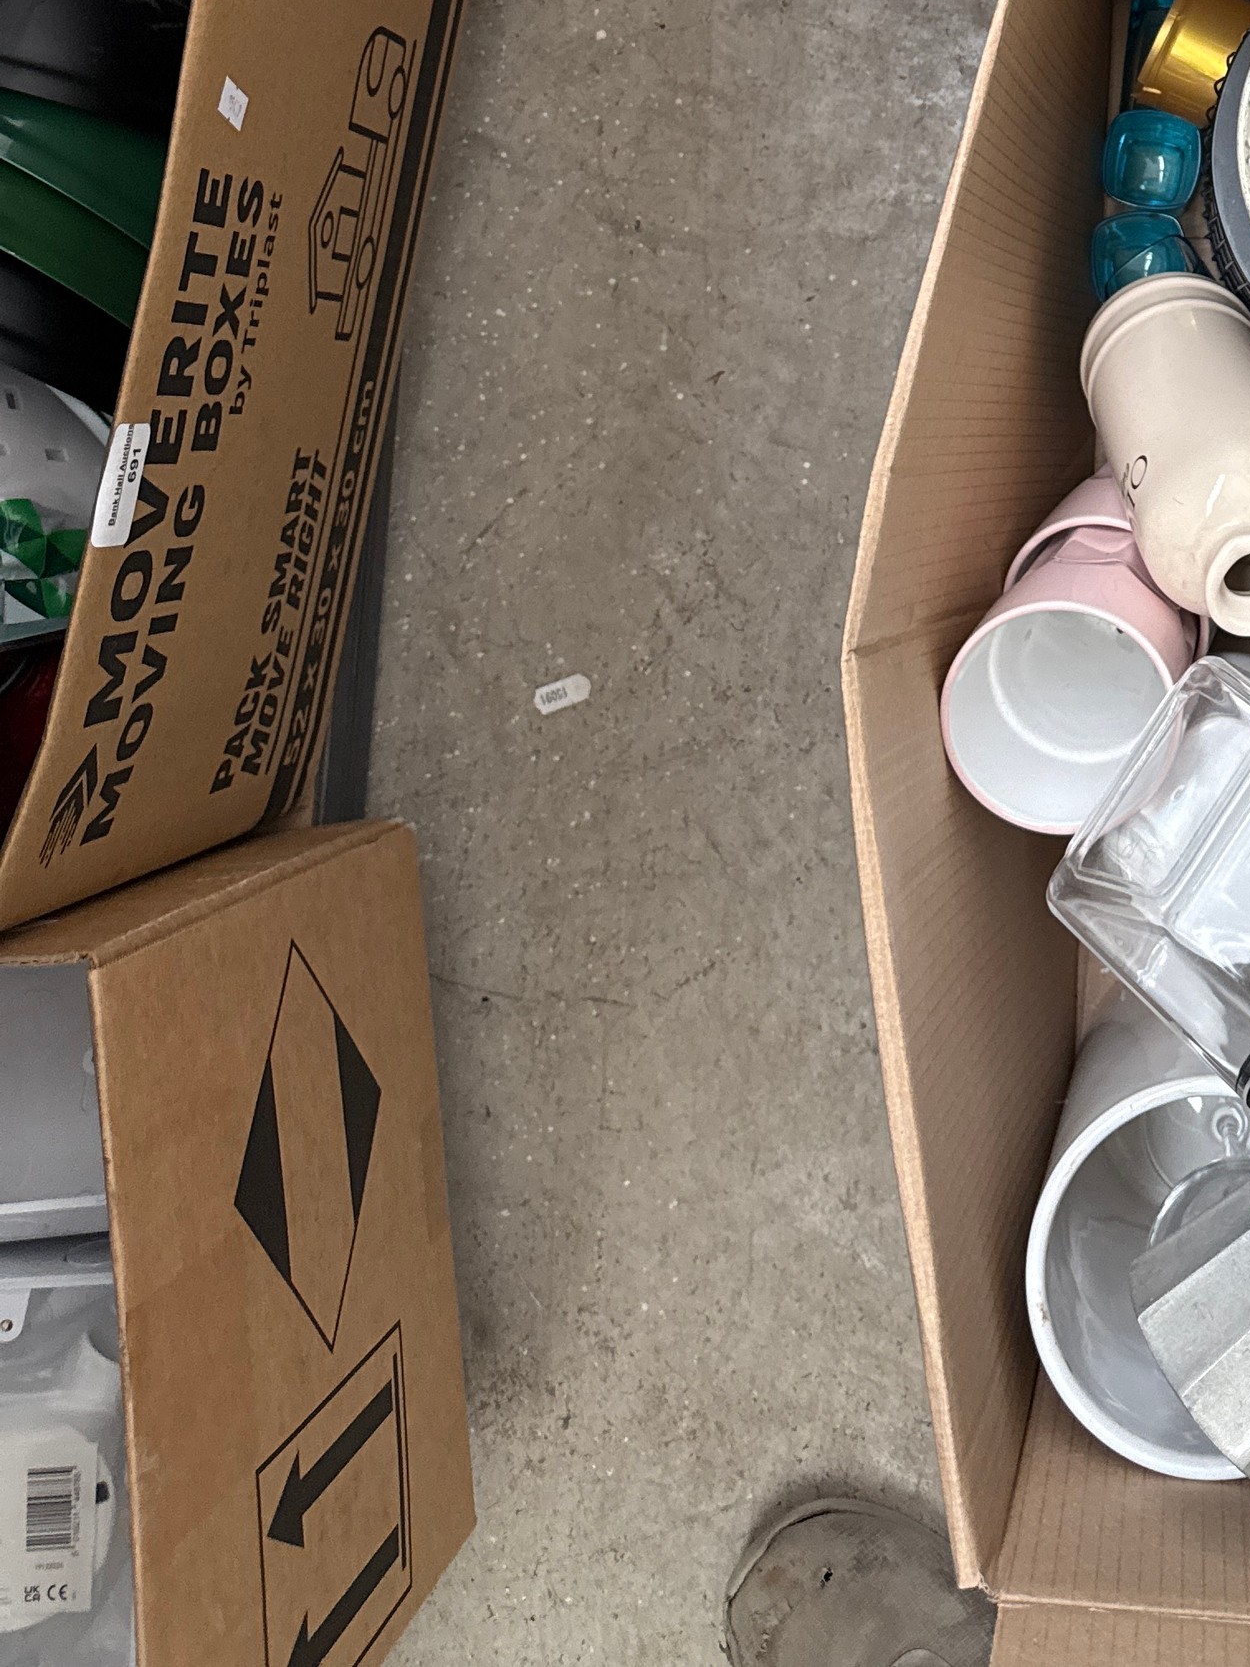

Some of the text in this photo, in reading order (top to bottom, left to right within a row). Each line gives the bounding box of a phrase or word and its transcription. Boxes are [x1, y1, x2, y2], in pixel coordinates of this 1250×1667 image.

[83, 167, 233, 728] MOVERITE
[229, 191, 283, 415] by Triplast
[79, 176, 264, 846] MOVING BOXES
[108, 498, 120, 526] Bank
[114, 474, 124, 495] Hall
[127, 447, 142, 483] 691
[209, 446, 313, 795] PACK SMART
[240, 448, 328, 776] MOVE RIGHT
[303, 670, 316, 692] x
[312, 592, 333, 645] 30
[336, 470, 356, 526] 30
[353, 381, 376, 453] cm
